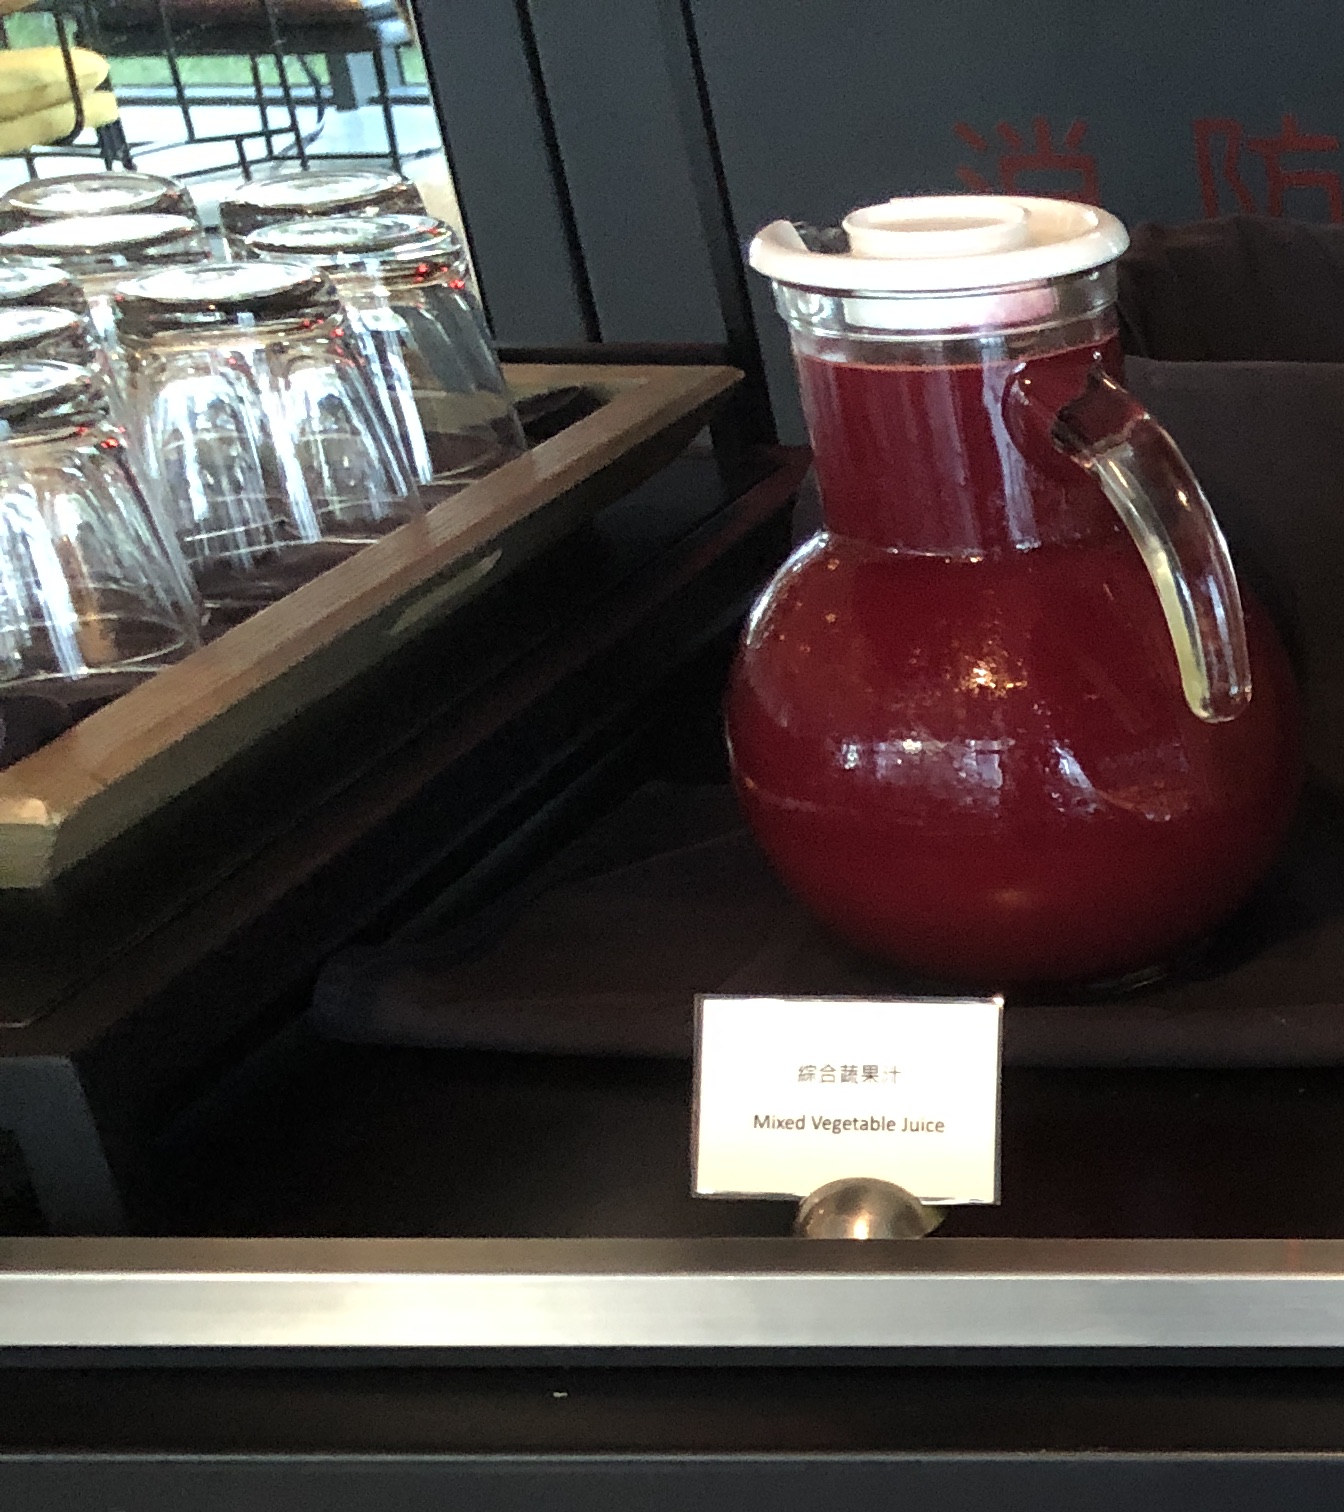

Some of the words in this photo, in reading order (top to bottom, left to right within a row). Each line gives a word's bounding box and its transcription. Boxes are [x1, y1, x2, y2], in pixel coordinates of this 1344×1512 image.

[797, 1063, 901, 1085] 綜合蔬果汁
[753, 1114, 806, 1131] Mixed
[811, 1115, 896, 1134] Vegetable
[901, 1117, 945, 1133] Juice
